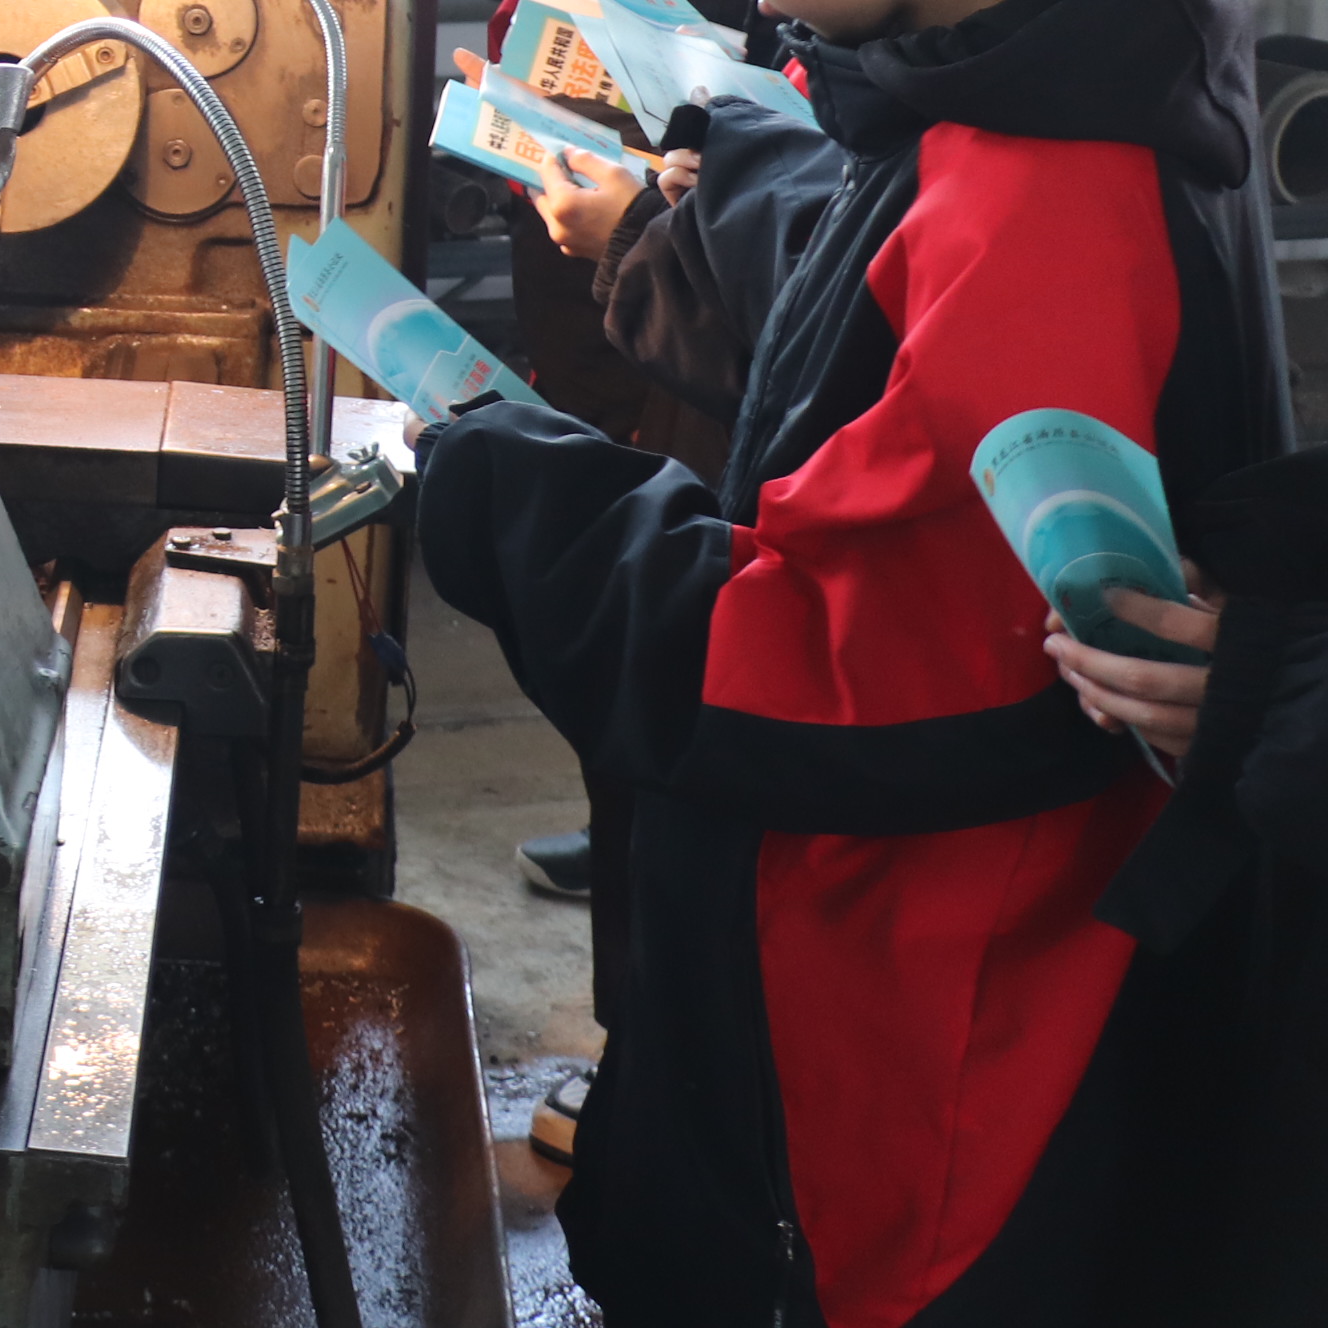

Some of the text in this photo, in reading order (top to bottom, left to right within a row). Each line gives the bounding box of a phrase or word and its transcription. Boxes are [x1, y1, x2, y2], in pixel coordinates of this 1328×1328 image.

[544, 26, 575, 93] 华人民共和国
